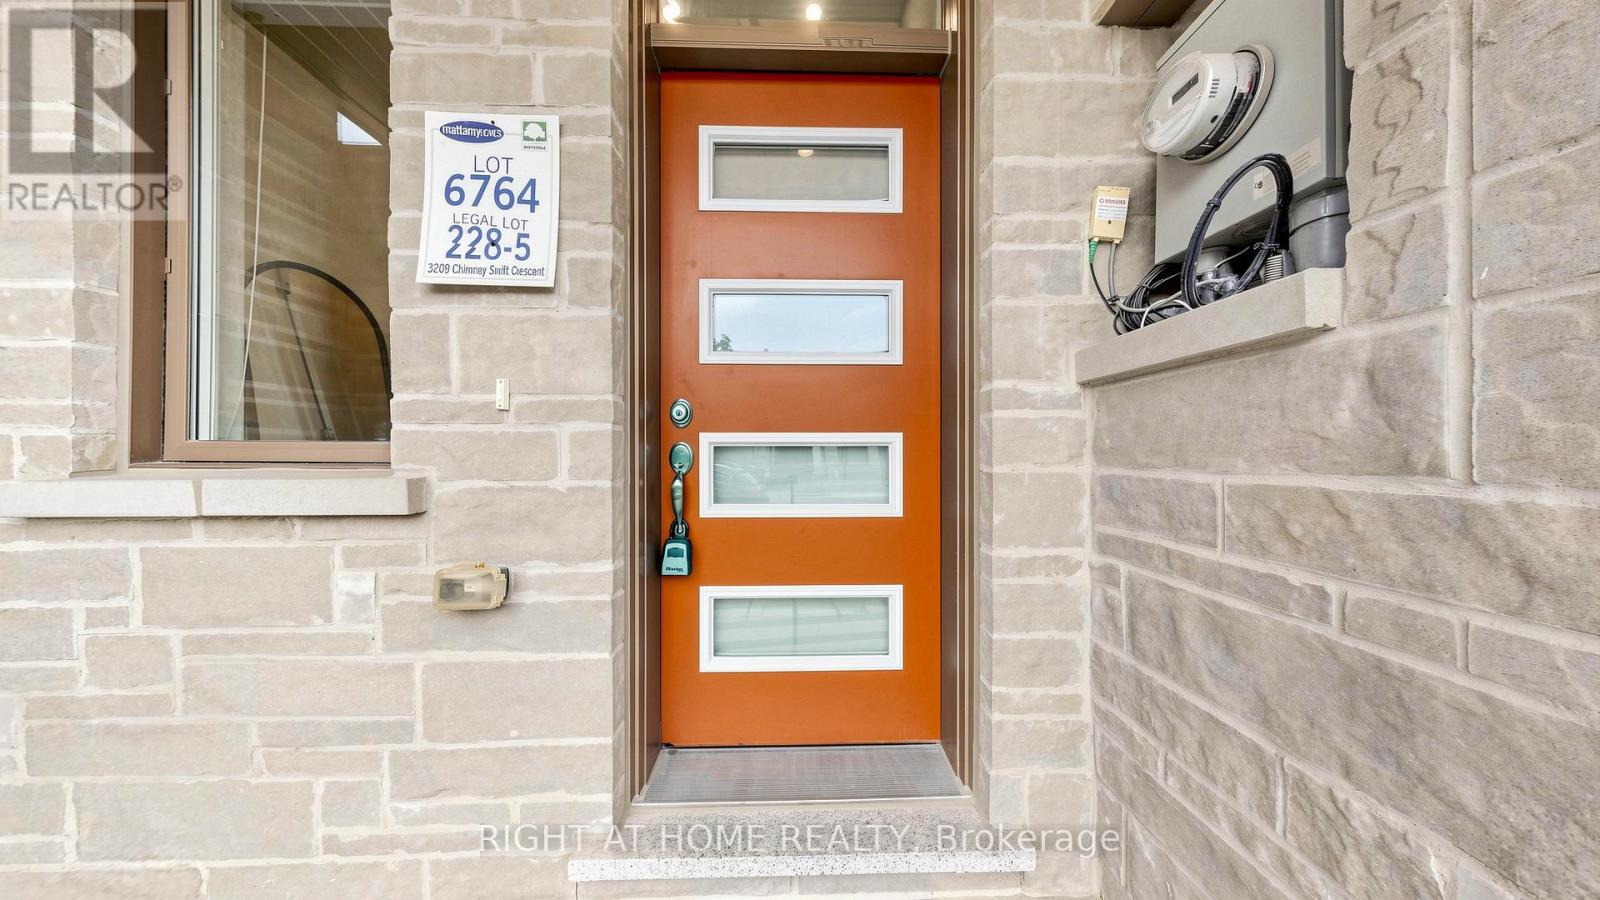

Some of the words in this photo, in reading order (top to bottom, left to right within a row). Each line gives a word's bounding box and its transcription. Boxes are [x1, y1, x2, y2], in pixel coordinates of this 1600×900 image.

[474, 155, 514, 174] LOT
[444, 173, 540, 213] 6764
[453, 213, 497, 227] LEGAL
[503, 216, 529, 231] LOT
[445, 224, 531, 261] 228-5
[428, 262, 450, 275] 3209
[452, 263, 487, 277] Chimney
[489, 265, 509, 276] Swift
[511, 265, 545, 277] Crescent
